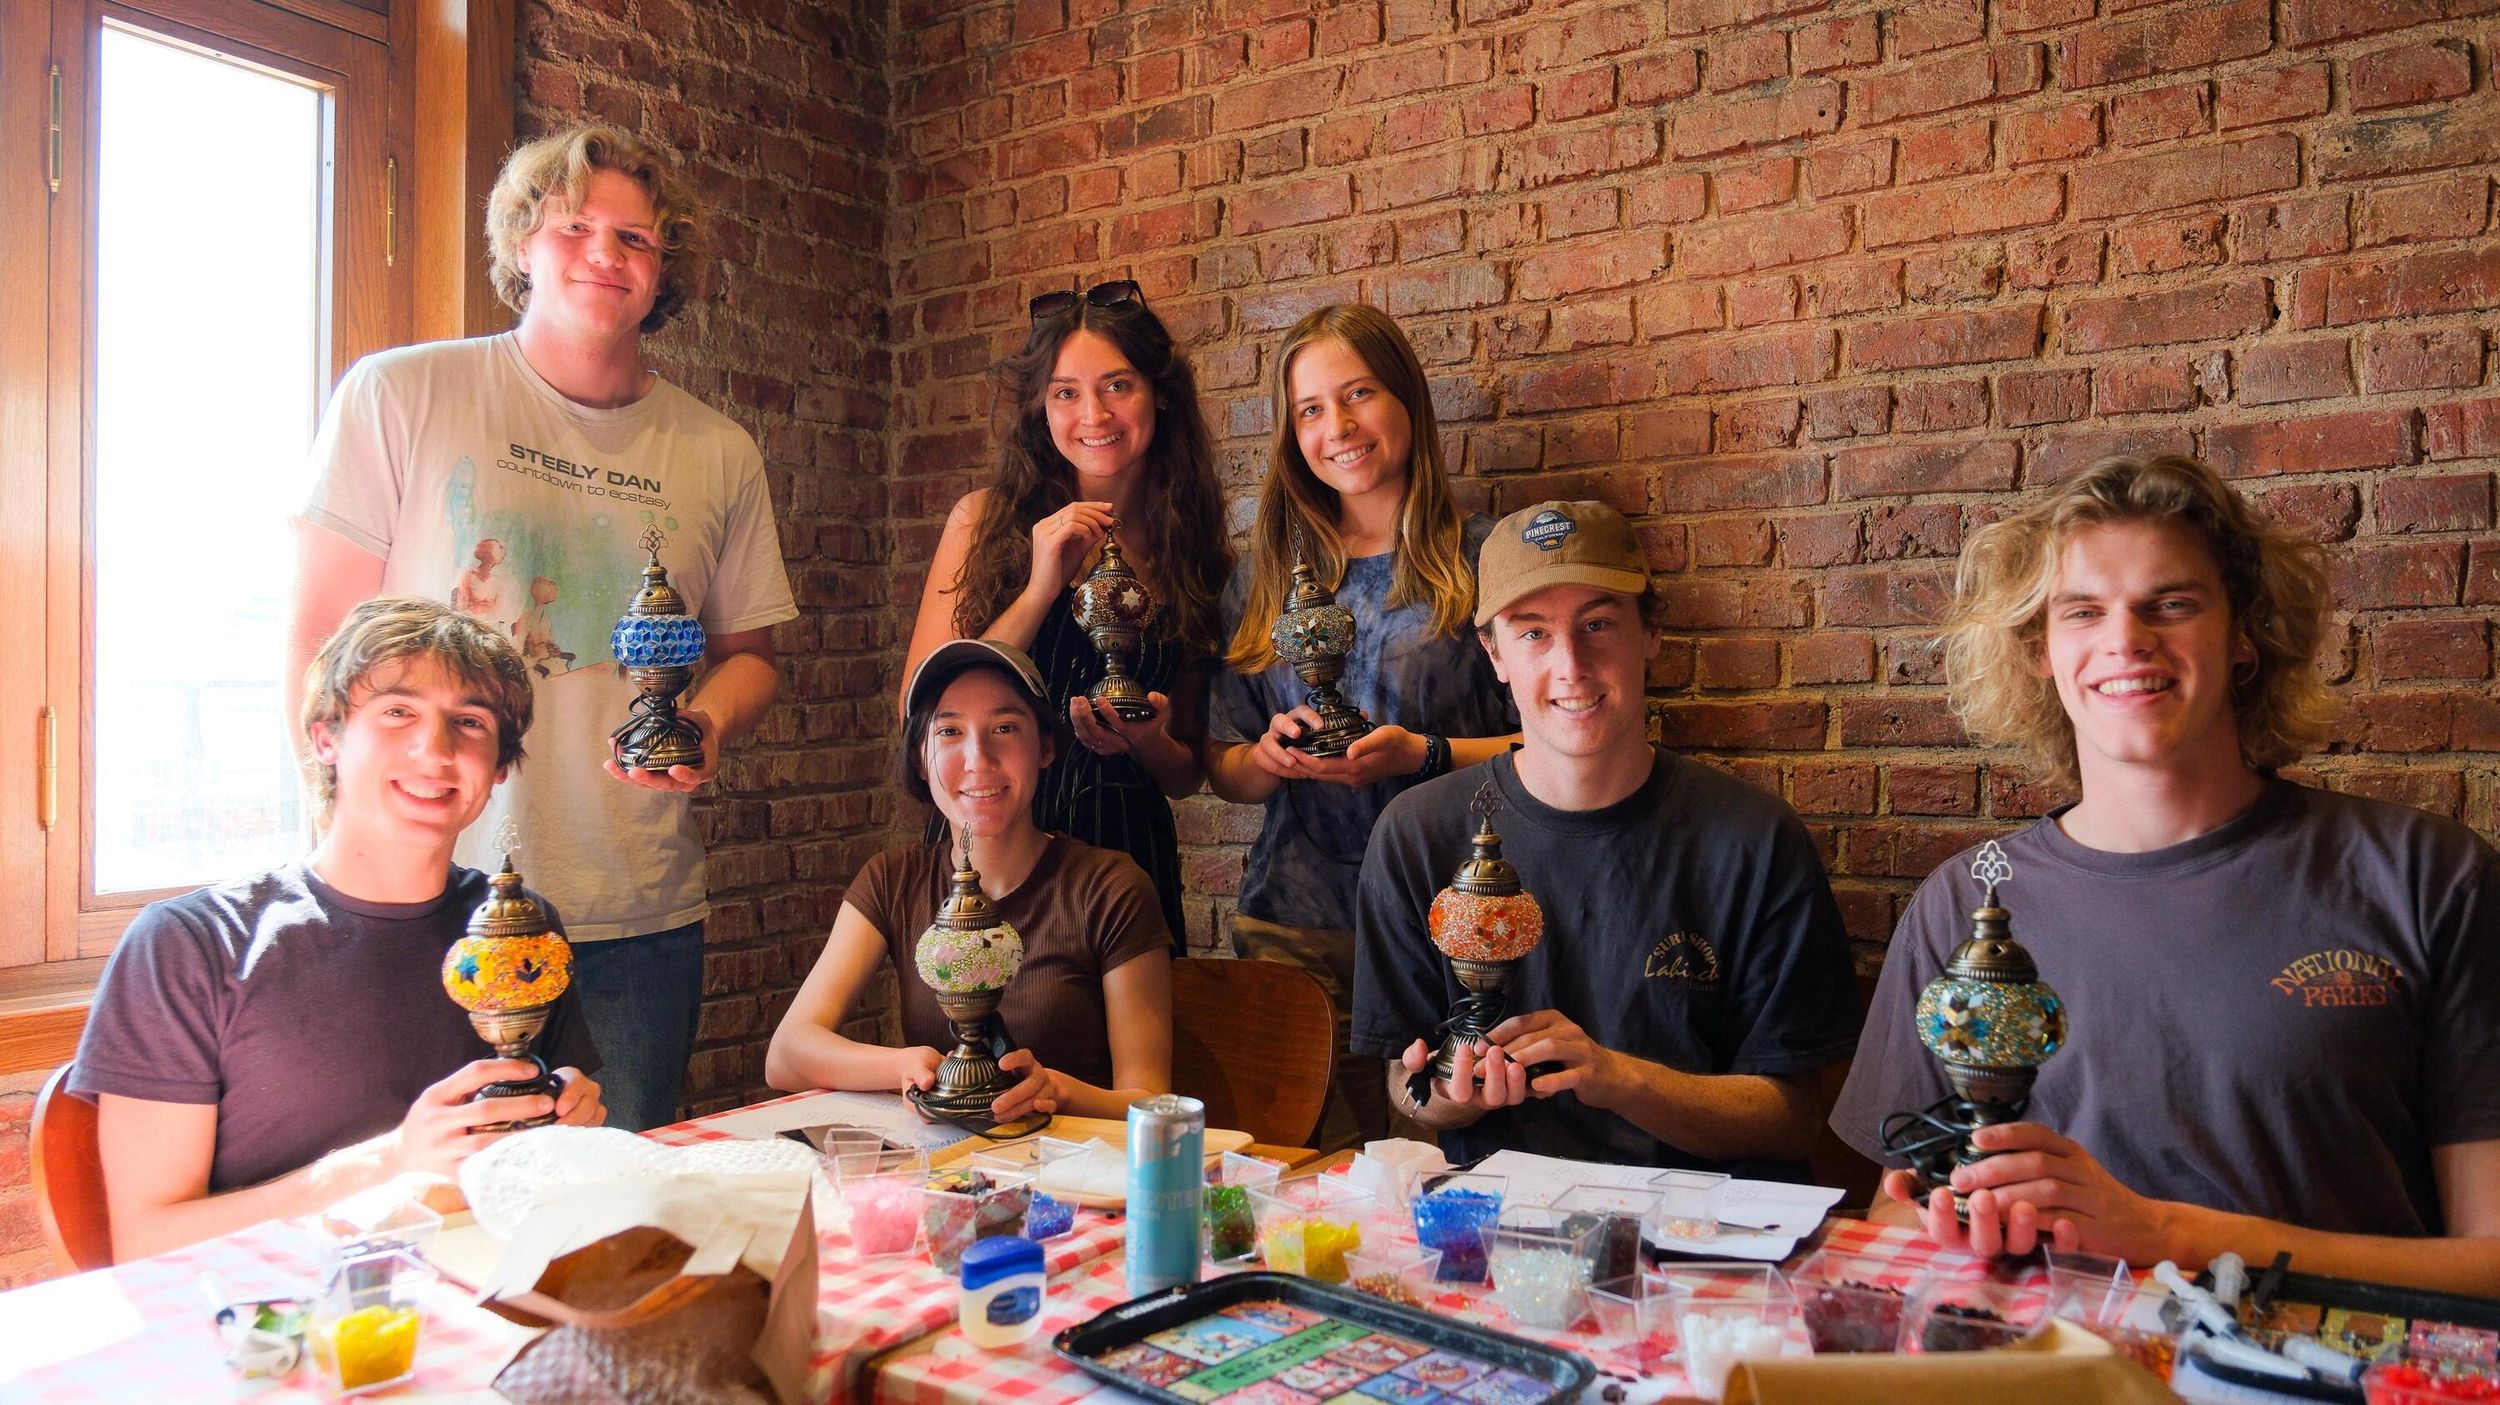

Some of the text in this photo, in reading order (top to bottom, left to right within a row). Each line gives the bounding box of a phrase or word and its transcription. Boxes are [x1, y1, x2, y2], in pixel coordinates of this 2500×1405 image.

[497, 459, 671, 510] countdown to ecstasy
[510, 443, 661, 493] STEELY DAN
[1526, 522, 1571, 538] PINECREST
[2303, 985, 2387, 1008] PARKS
